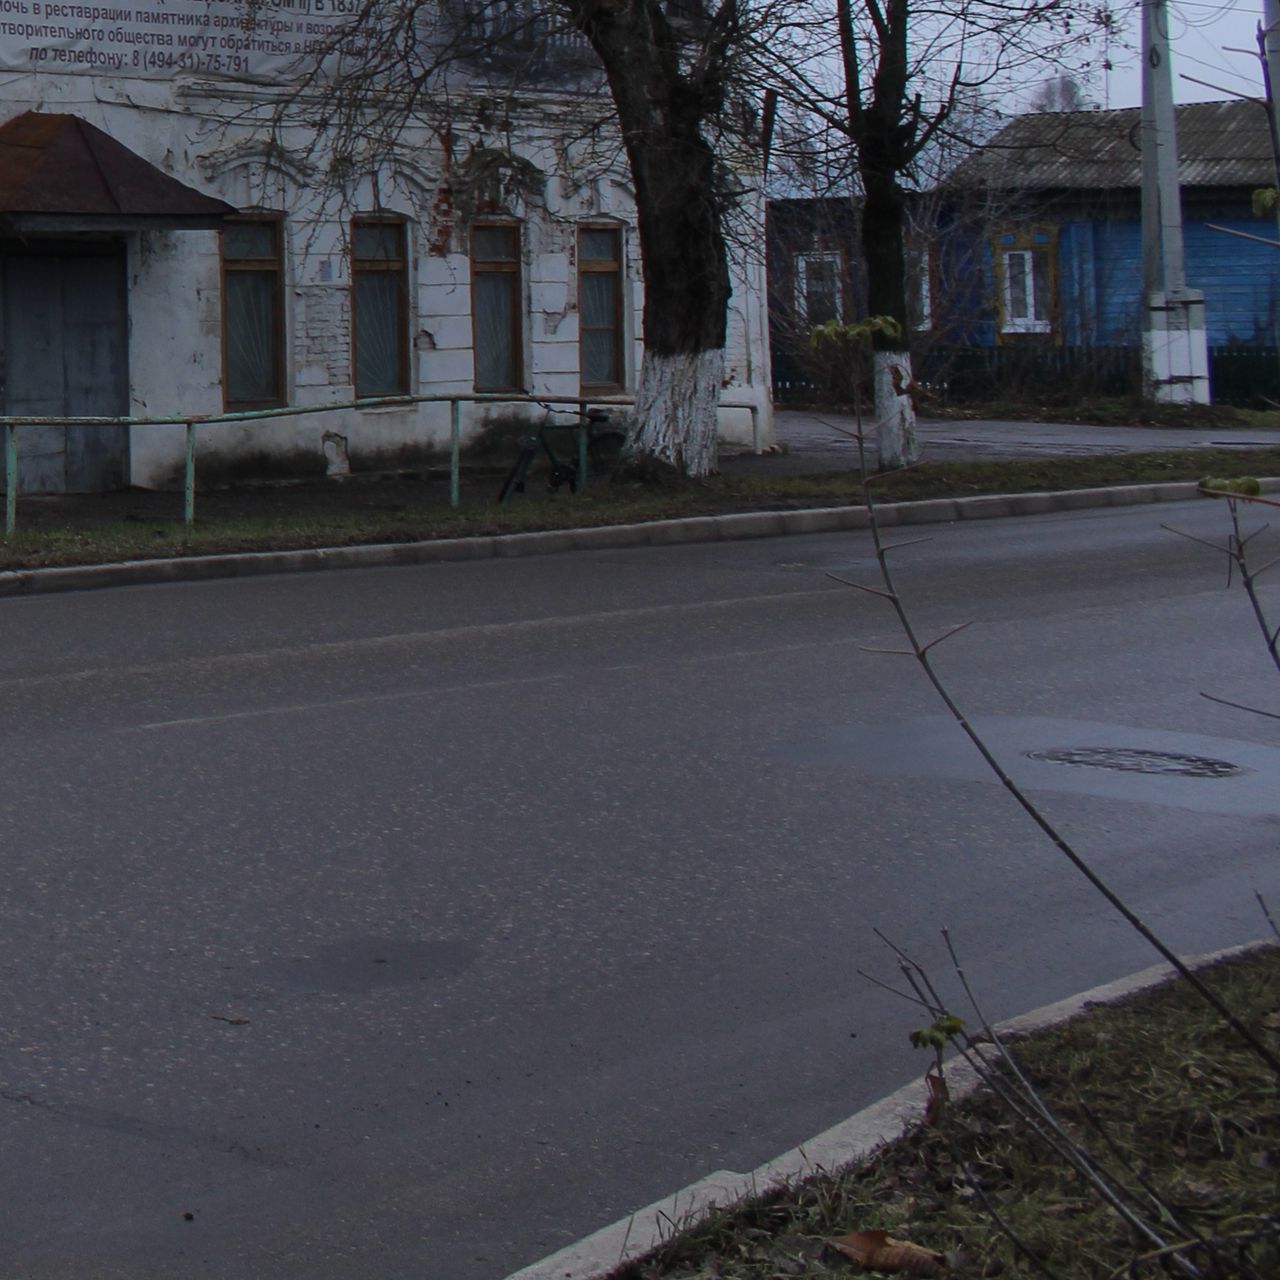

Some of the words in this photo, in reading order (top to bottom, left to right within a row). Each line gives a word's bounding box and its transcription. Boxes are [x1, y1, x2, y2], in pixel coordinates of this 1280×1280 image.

[32, 3, 41, 15] в
[45, 3, 132, 22] реставрации
[135, 11, 210, 27] памятника
[108, 27, 173, 47] общества
[177, 36, 216, 52] могут
[219, 36, 291, 53] обратиться
[29, 46, 48, 61] по
[51, 47, 128, 70] телефону:
[132, 51, 140, 67] 8
